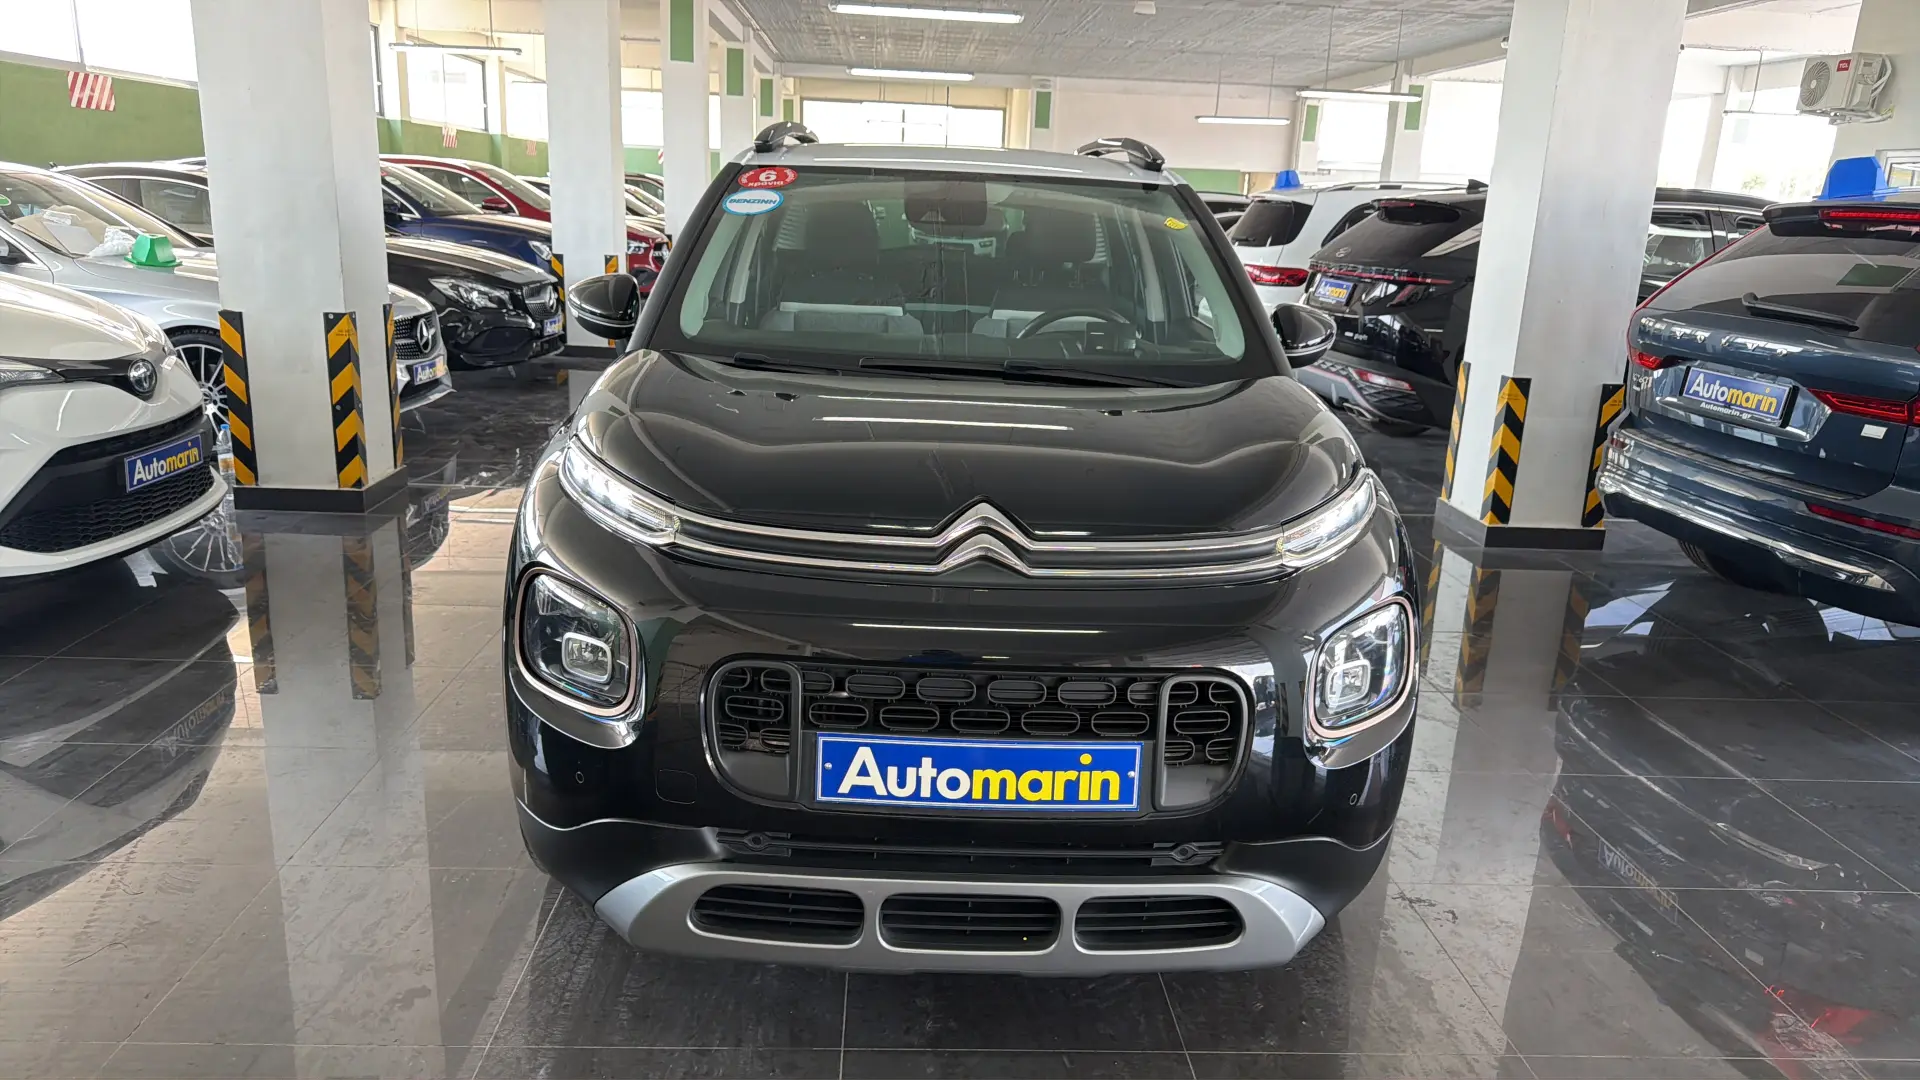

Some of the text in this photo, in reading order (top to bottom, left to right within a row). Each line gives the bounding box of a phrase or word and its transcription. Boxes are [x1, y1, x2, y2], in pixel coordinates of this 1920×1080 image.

[759, 170, 777, 182] 6
[1688, 373, 1777, 414] Automarin
[1700, 401, 1751, 420] Automarin.gr
[133, 441, 199, 485] Automarin
[837, 746, 1121, 801] Automarin
